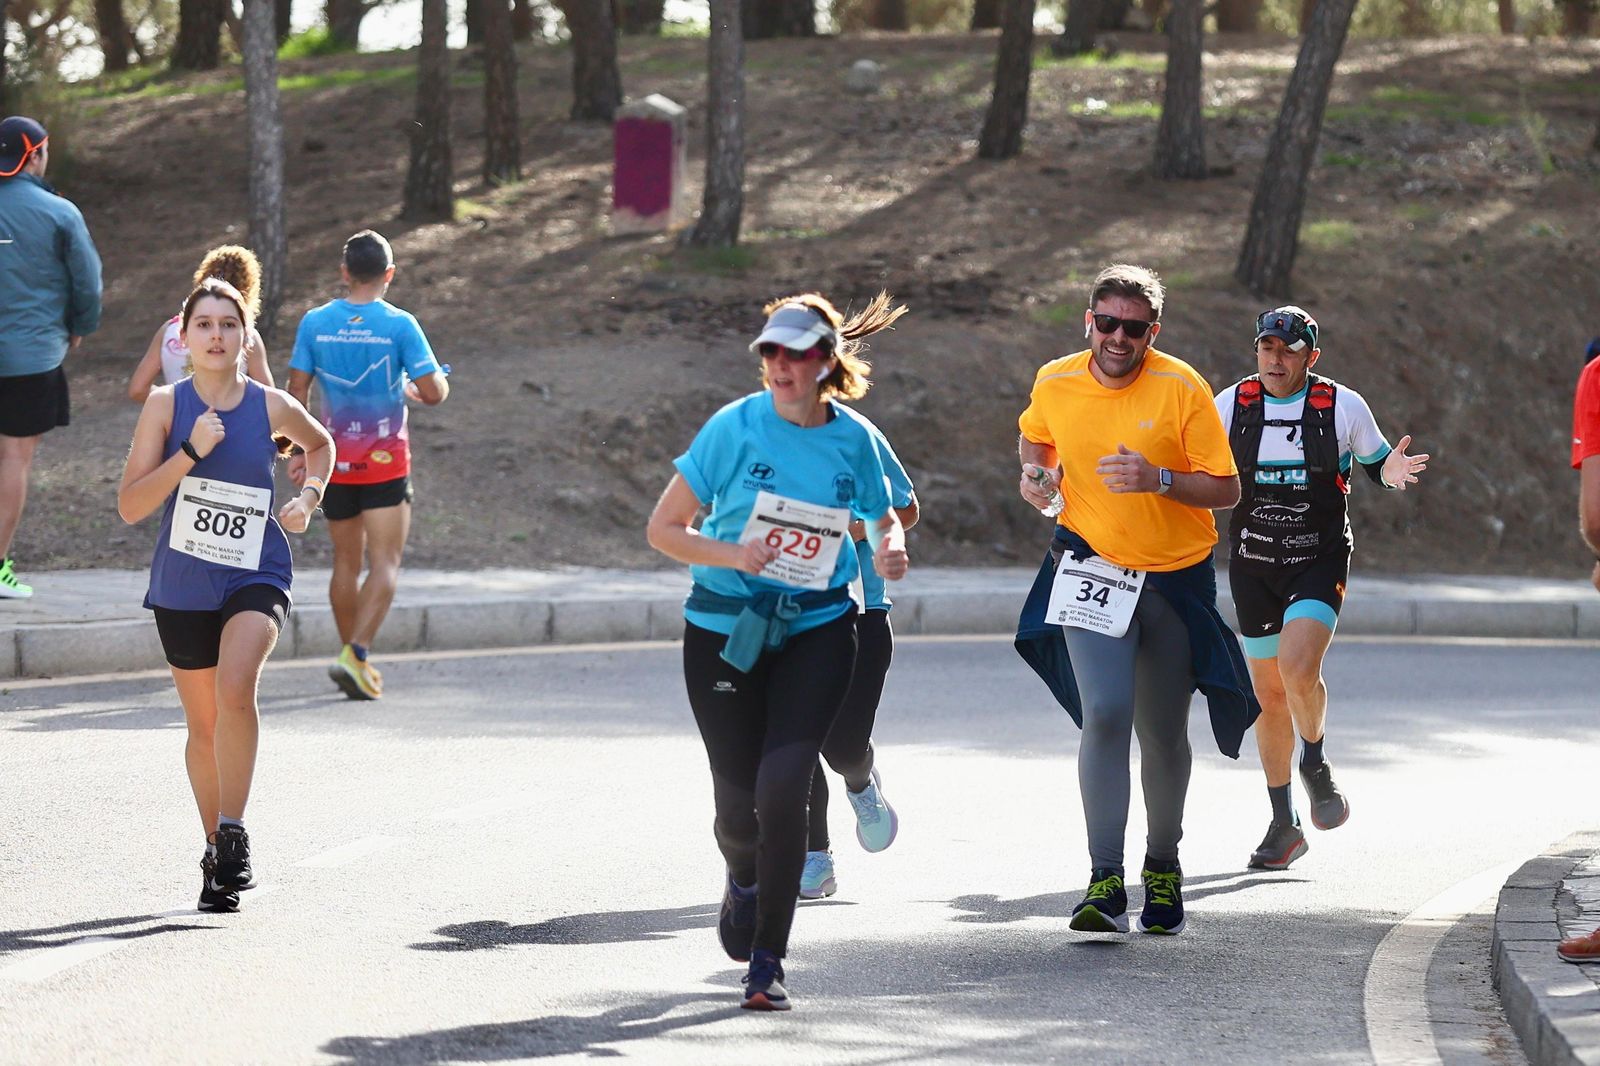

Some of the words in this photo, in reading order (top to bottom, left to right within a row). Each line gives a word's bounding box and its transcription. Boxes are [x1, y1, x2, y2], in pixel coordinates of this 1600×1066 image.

[743, 479, 776, 490] HYUNDAI
[1250, 505, 1304, 521] Lucena
[193, 508, 247, 539] 808
[765, 528, 822, 560] 629
[1075, 580, 1111, 608] 34
[1068, 615, 1082, 623] PEÑA
[1088, 620, 1110, 630] BASTÓN
[1077, 610, 1088, 618] MINI
[1088, 613, 1113, 625] MARATÓN
